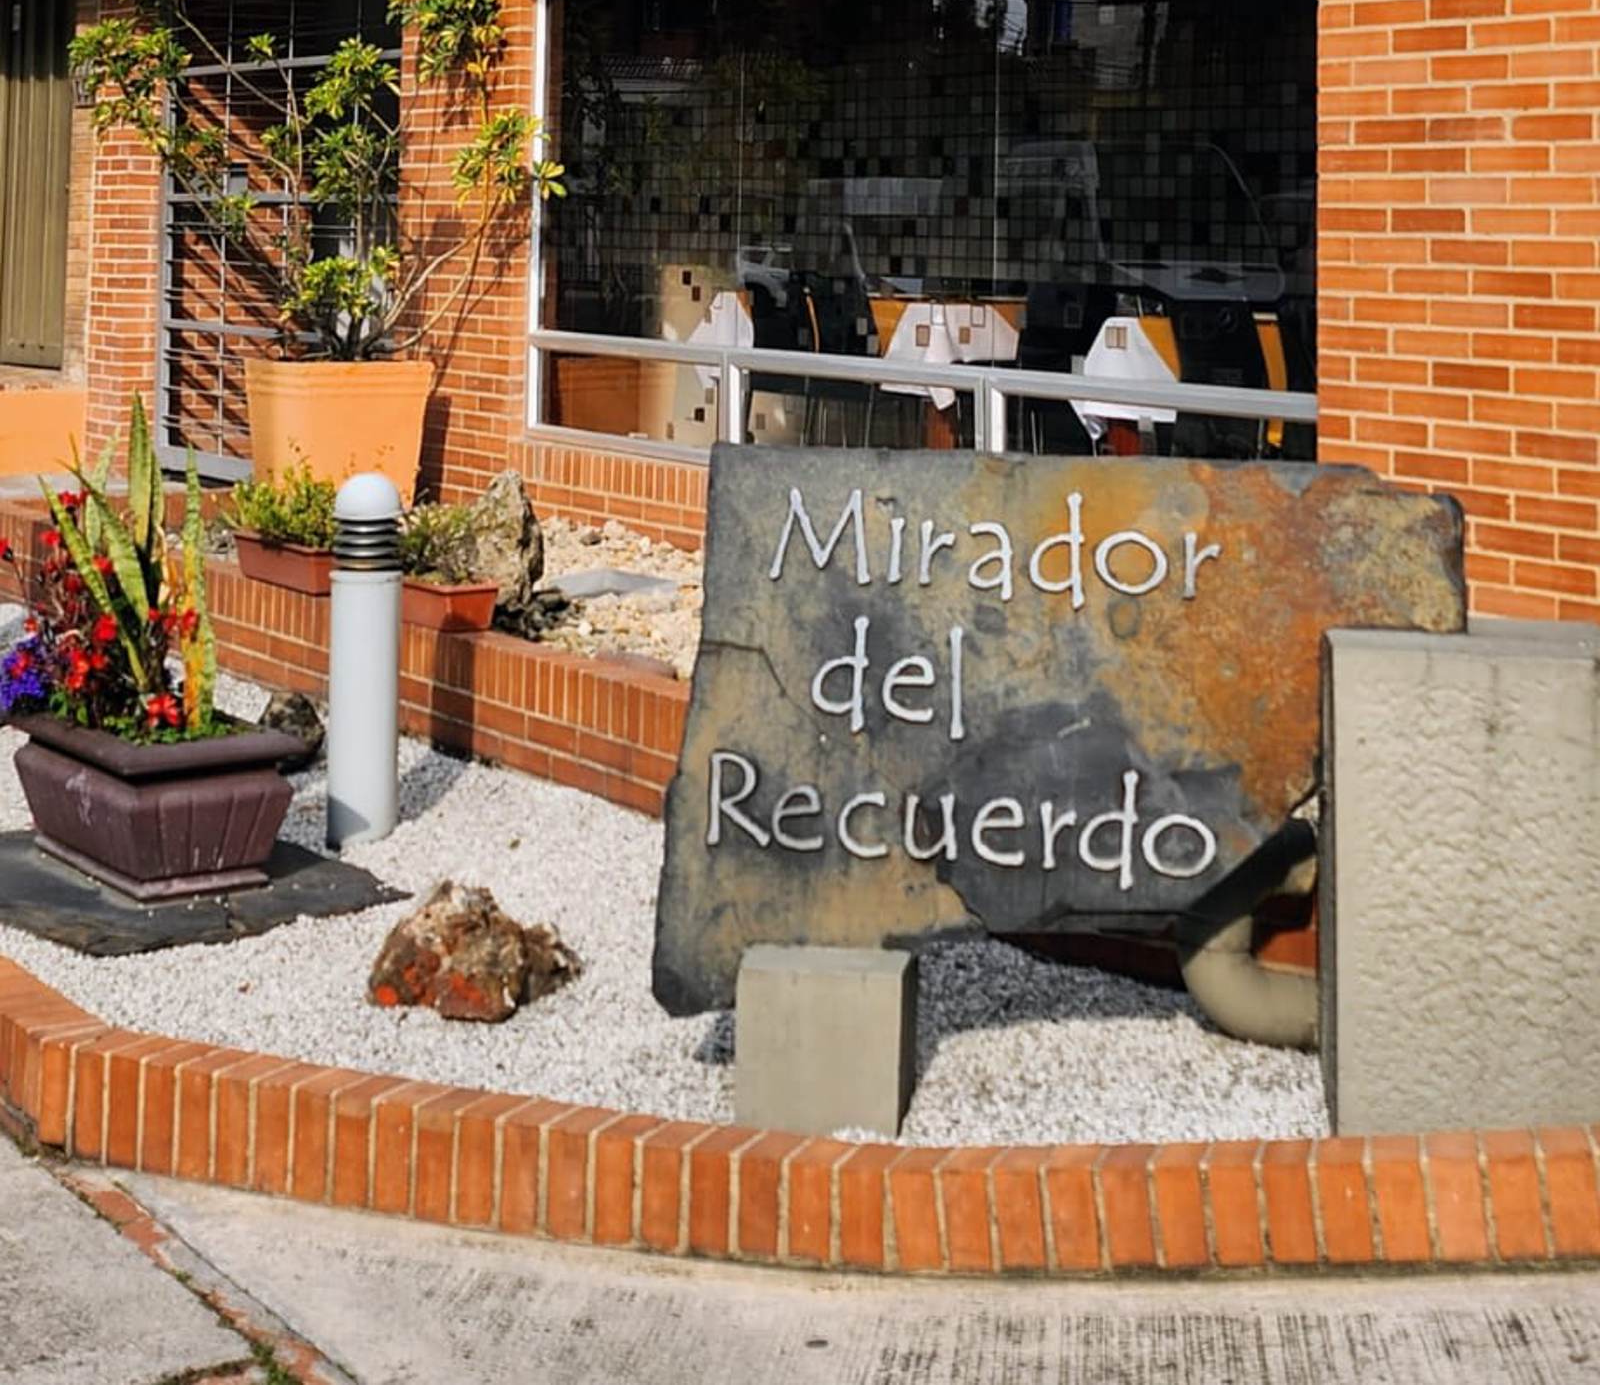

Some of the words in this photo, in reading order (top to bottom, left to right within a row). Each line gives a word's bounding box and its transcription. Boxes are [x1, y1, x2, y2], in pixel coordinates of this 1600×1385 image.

[769, 487, 1221, 610] Mirador
[811, 616, 966, 740] del
[706, 750, 1218, 891] Recuerdo
